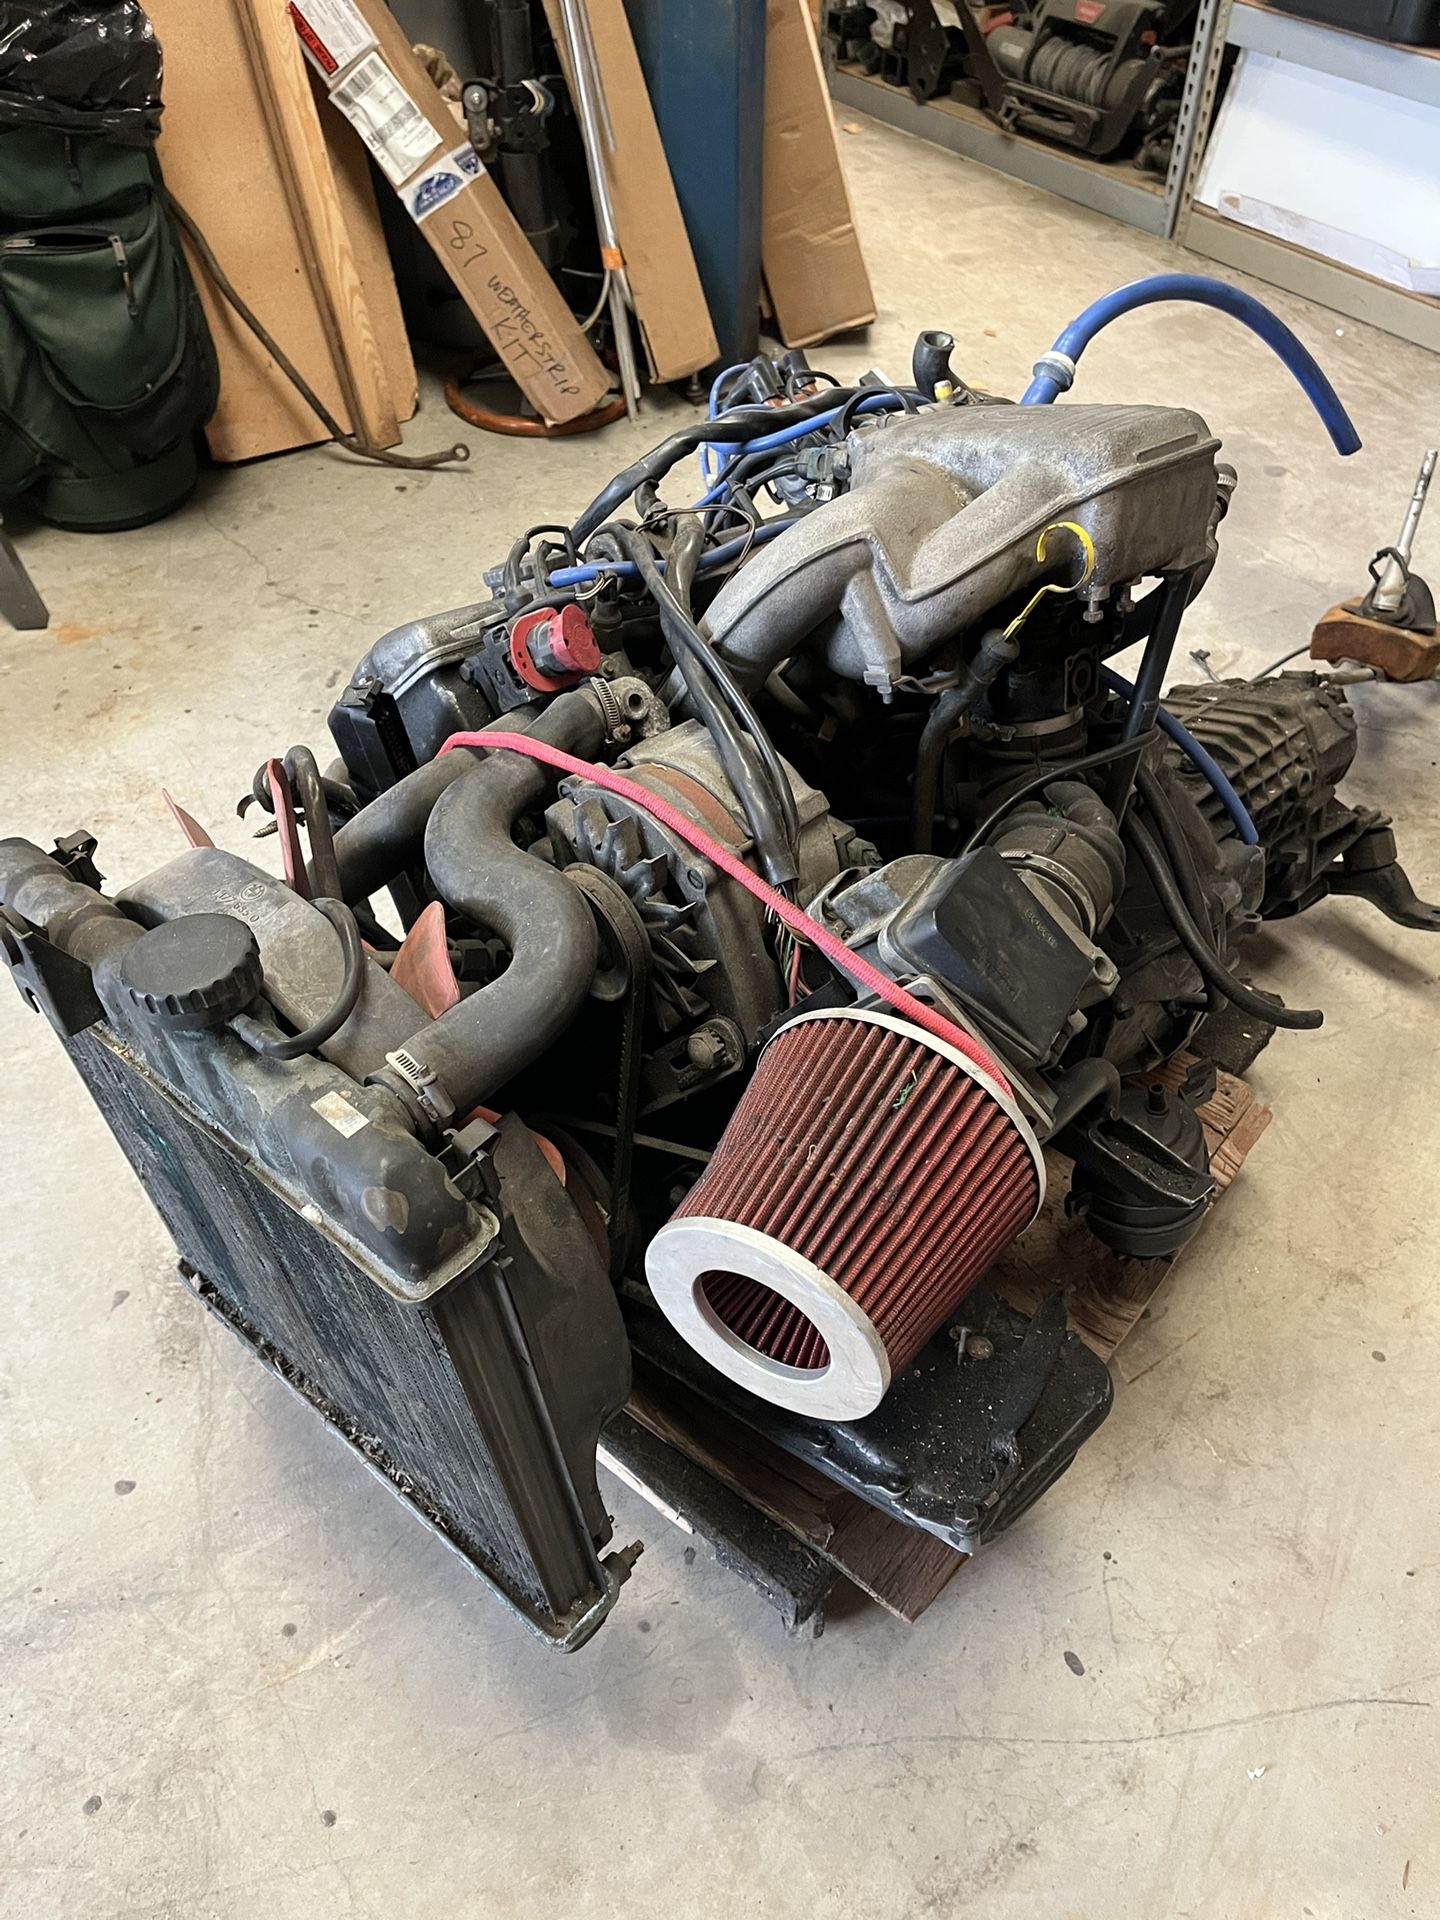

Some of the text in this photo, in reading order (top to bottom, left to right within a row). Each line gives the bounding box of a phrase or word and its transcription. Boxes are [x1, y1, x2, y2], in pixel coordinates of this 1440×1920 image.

[450, 220, 487, 268] 87
[487, 274, 581, 395] WEATHERSTRIP
[490, 317, 544, 369] KIT
